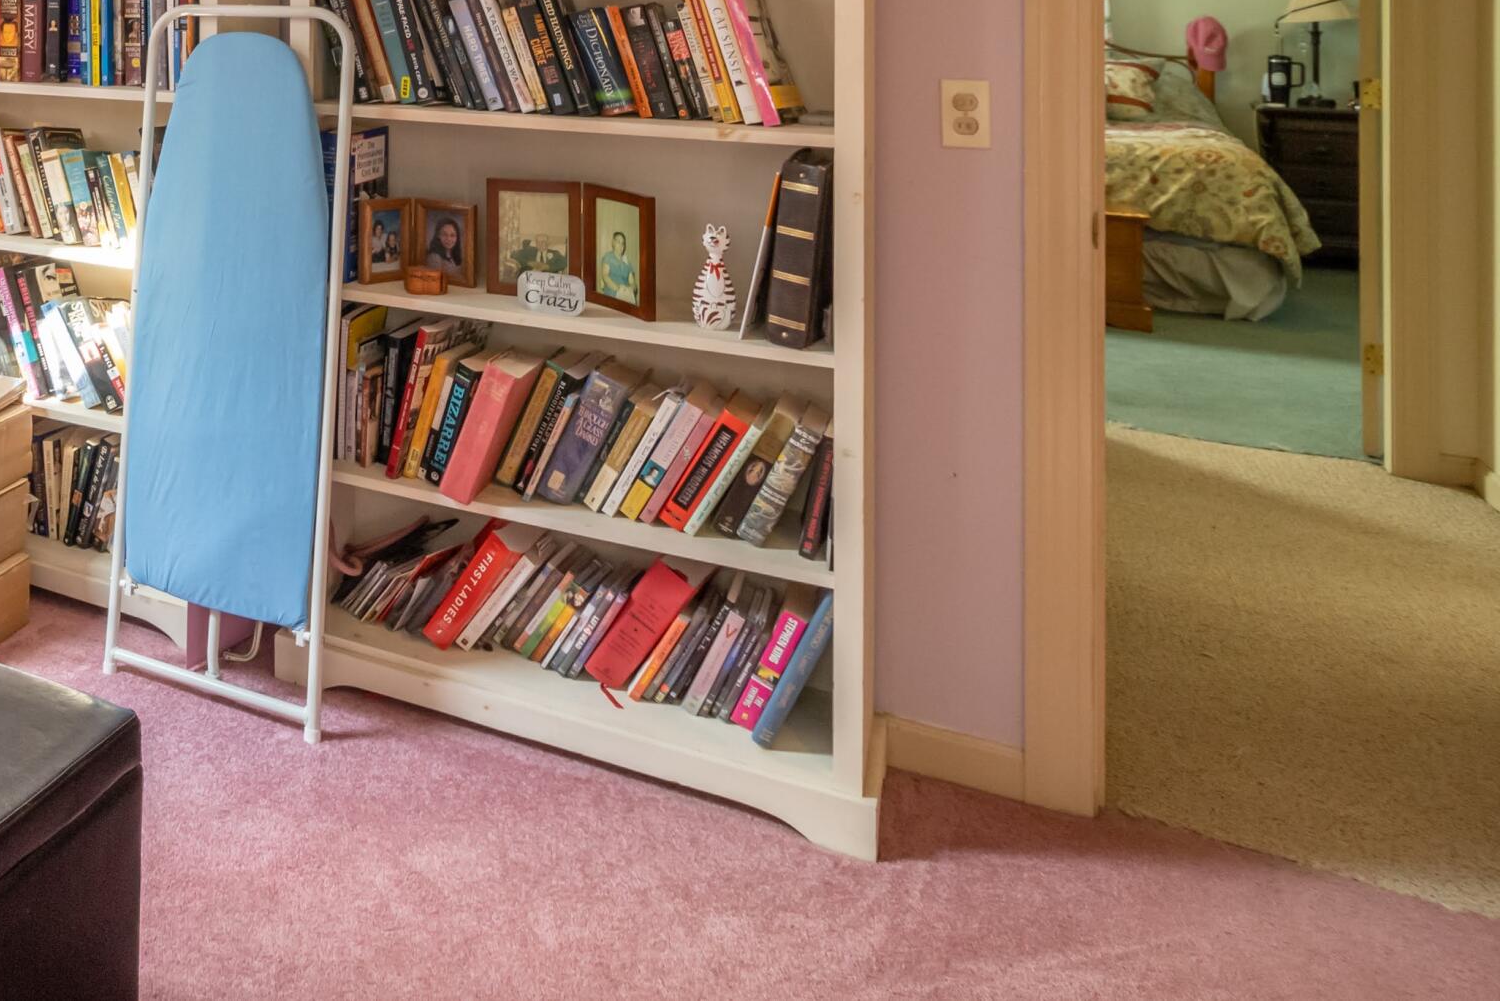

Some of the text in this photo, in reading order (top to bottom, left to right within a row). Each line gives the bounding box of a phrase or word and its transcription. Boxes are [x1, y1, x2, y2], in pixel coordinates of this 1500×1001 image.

[23, 4, 36, 51] MARY
[396, 0, 412, 39] PALE-FACED
[410, 52, 419, 71] DAVID
[462, 24, 488, 84] HARD TIMES
[489, 14, 502, 42] TASTE
[500, 45, 513, 67] FOR
[550, 15, 574, 71] HAUNTINGS
[712, 7, 742, 75] CAT SENSE
[585, 27, 615, 98] DICTIONARY
[525, 271, 572, 290] Keep Calm
[525, 289, 580, 313] Crazy
[434, 383, 466, 464] BIZARRE
[545, 380, 567, 423] BLOODIEST
[706, 430, 732, 468] INFAMOUS
[443, 551, 494, 624] FIRST LADIES
[768, 616, 799, 665] STEPHEN KING
